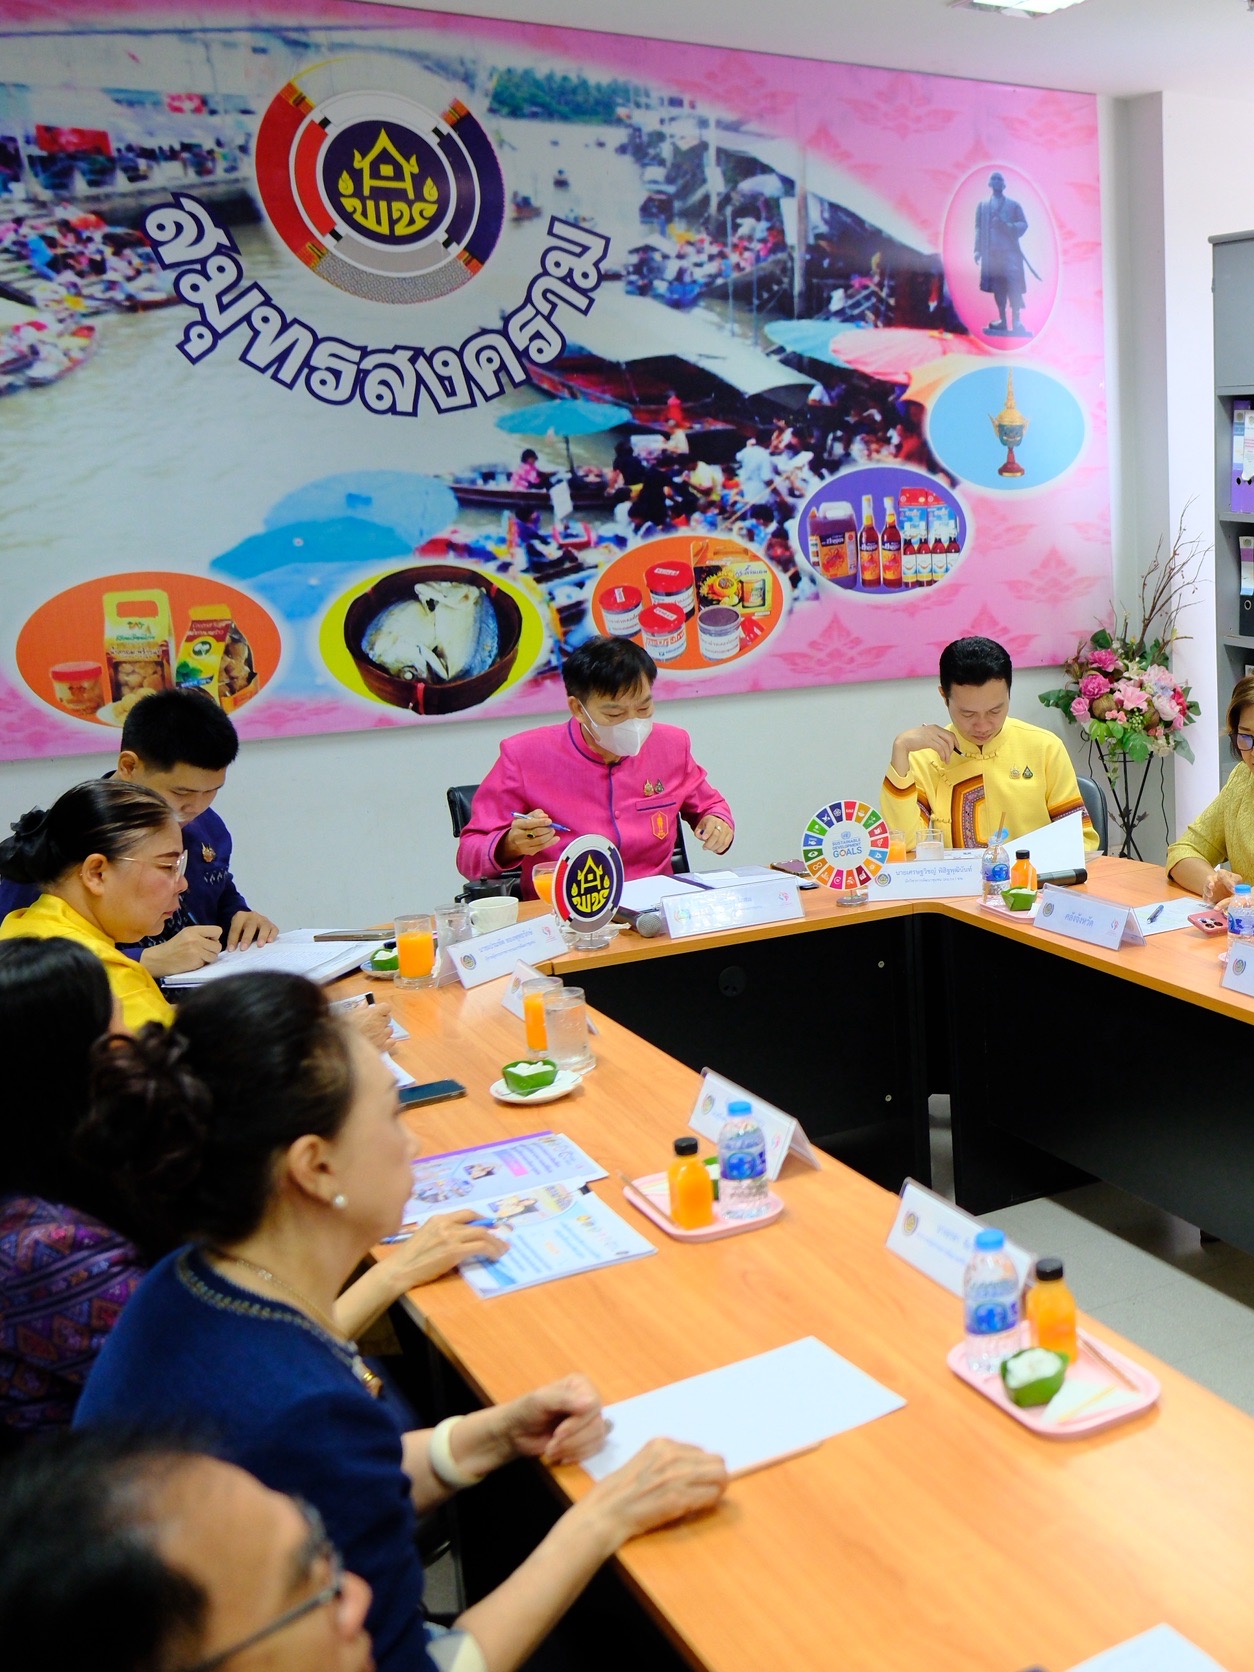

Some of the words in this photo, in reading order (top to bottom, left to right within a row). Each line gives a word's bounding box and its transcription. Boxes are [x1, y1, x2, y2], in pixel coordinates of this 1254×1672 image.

[144, 191, 611, 418] สมุทรสงคราม
[832, 837, 861, 846] SUSTAINABLE
[832, 843, 862, 851] DEVELOPMENT
[833, 847, 862, 858] GOALS
[1064, 911, 1095, 928] คลังจังหวัด
